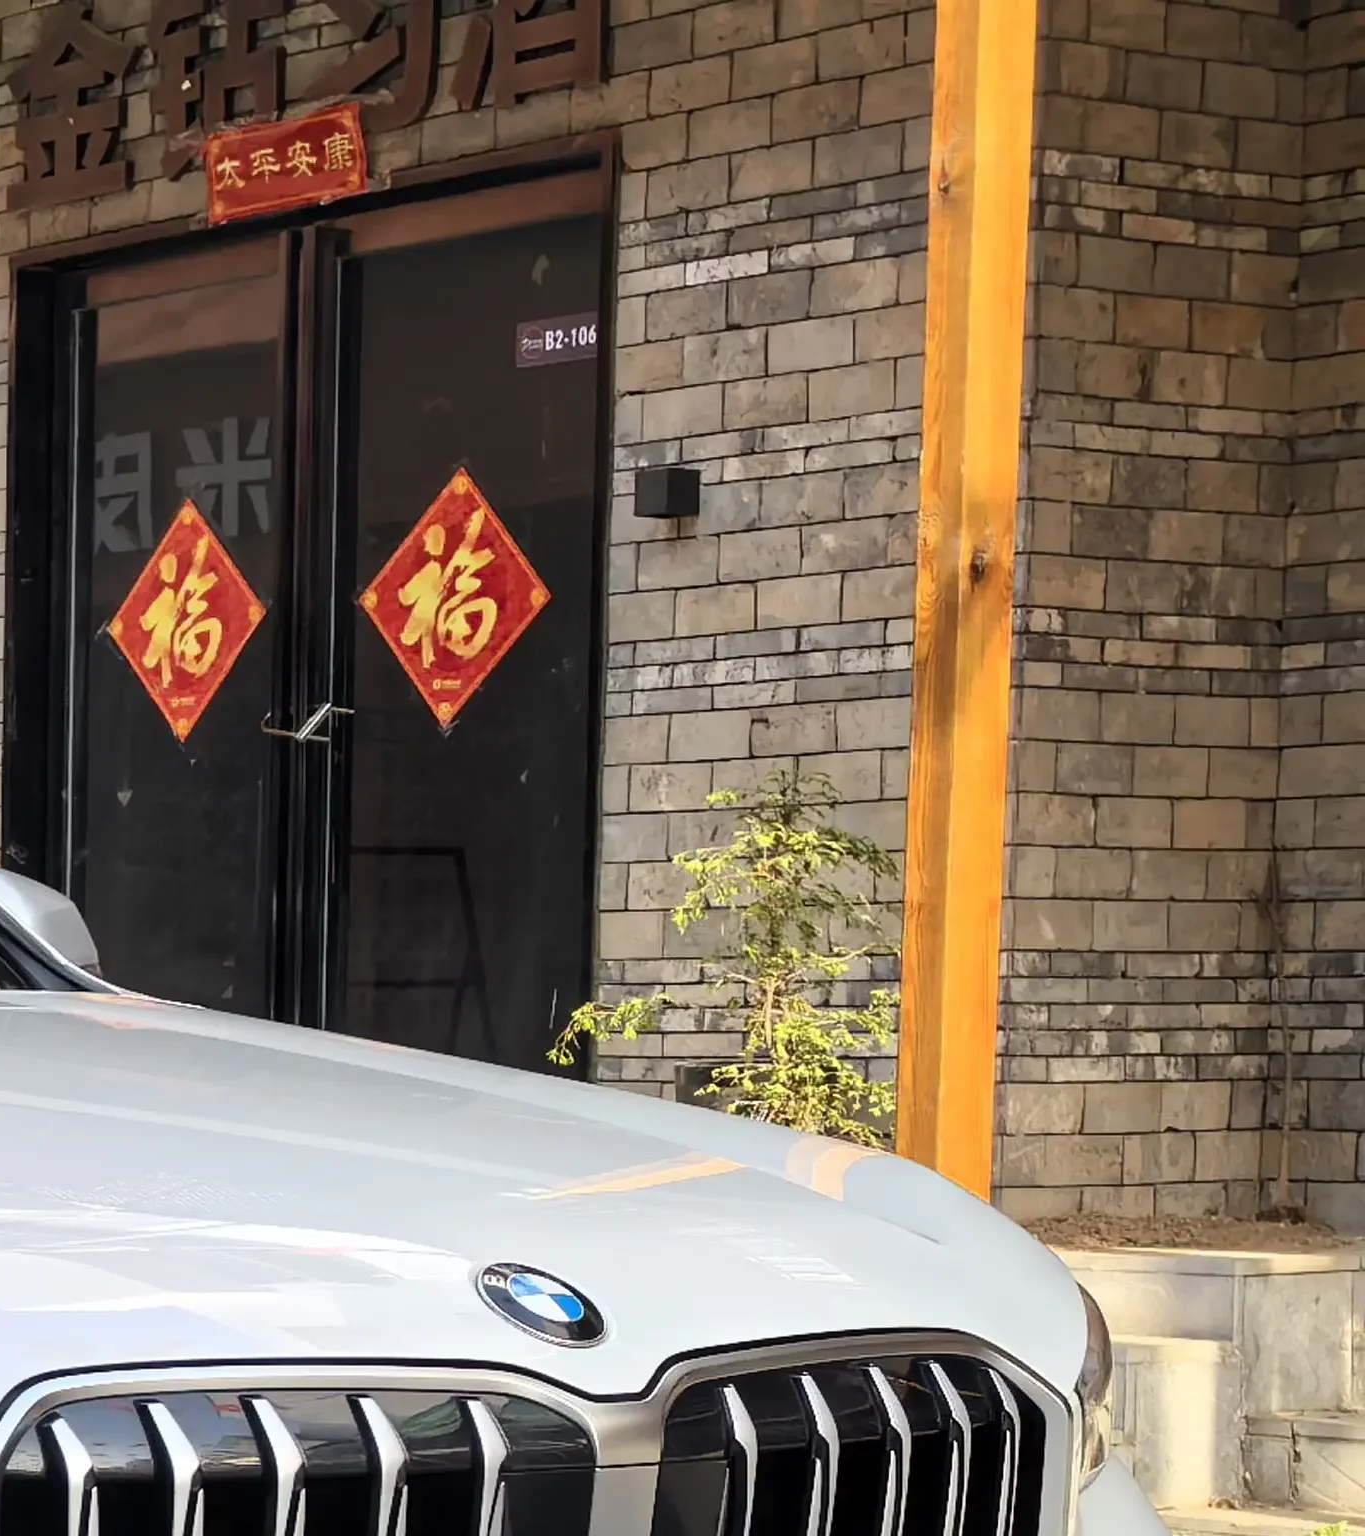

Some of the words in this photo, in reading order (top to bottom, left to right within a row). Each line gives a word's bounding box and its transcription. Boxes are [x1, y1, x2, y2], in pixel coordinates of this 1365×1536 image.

[215, 131, 356, 190] 太平安康
[140, 539, 223, 688] 福
[398, 509, 498, 668] 福
